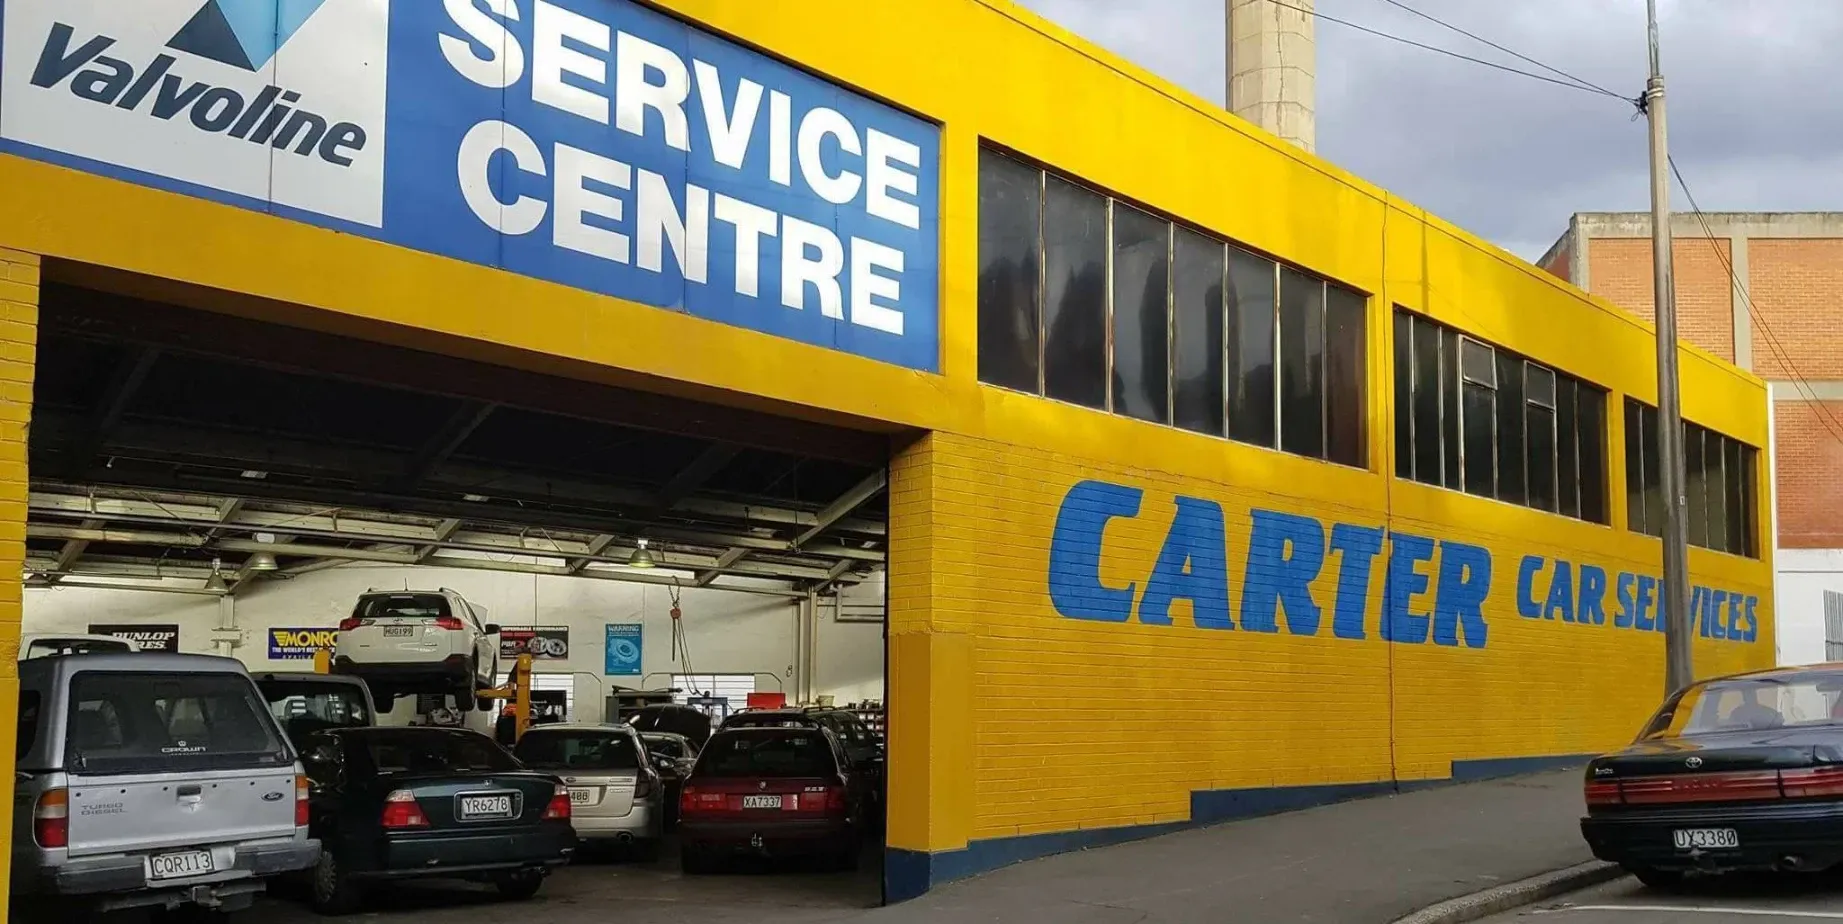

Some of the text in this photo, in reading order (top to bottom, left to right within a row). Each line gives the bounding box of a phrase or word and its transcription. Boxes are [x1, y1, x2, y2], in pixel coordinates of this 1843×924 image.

[30, 22, 367, 167] Valvoline
[438, 0, 920, 230] SERVICE
[457, 119, 904, 336] CENTRE
[1048, 479, 1492, 649] CARTER
[1516, 555, 1606, 625] CAR
[112, 632, 175, 641] DUNLOP
[284, 631, 339, 647] MONRO
[465, 798, 508, 812] YR6278
[745, 796, 780, 807] XA7337
[1675, 829, 1737, 847] UX3380
[154, 853, 210, 873] CQR113
